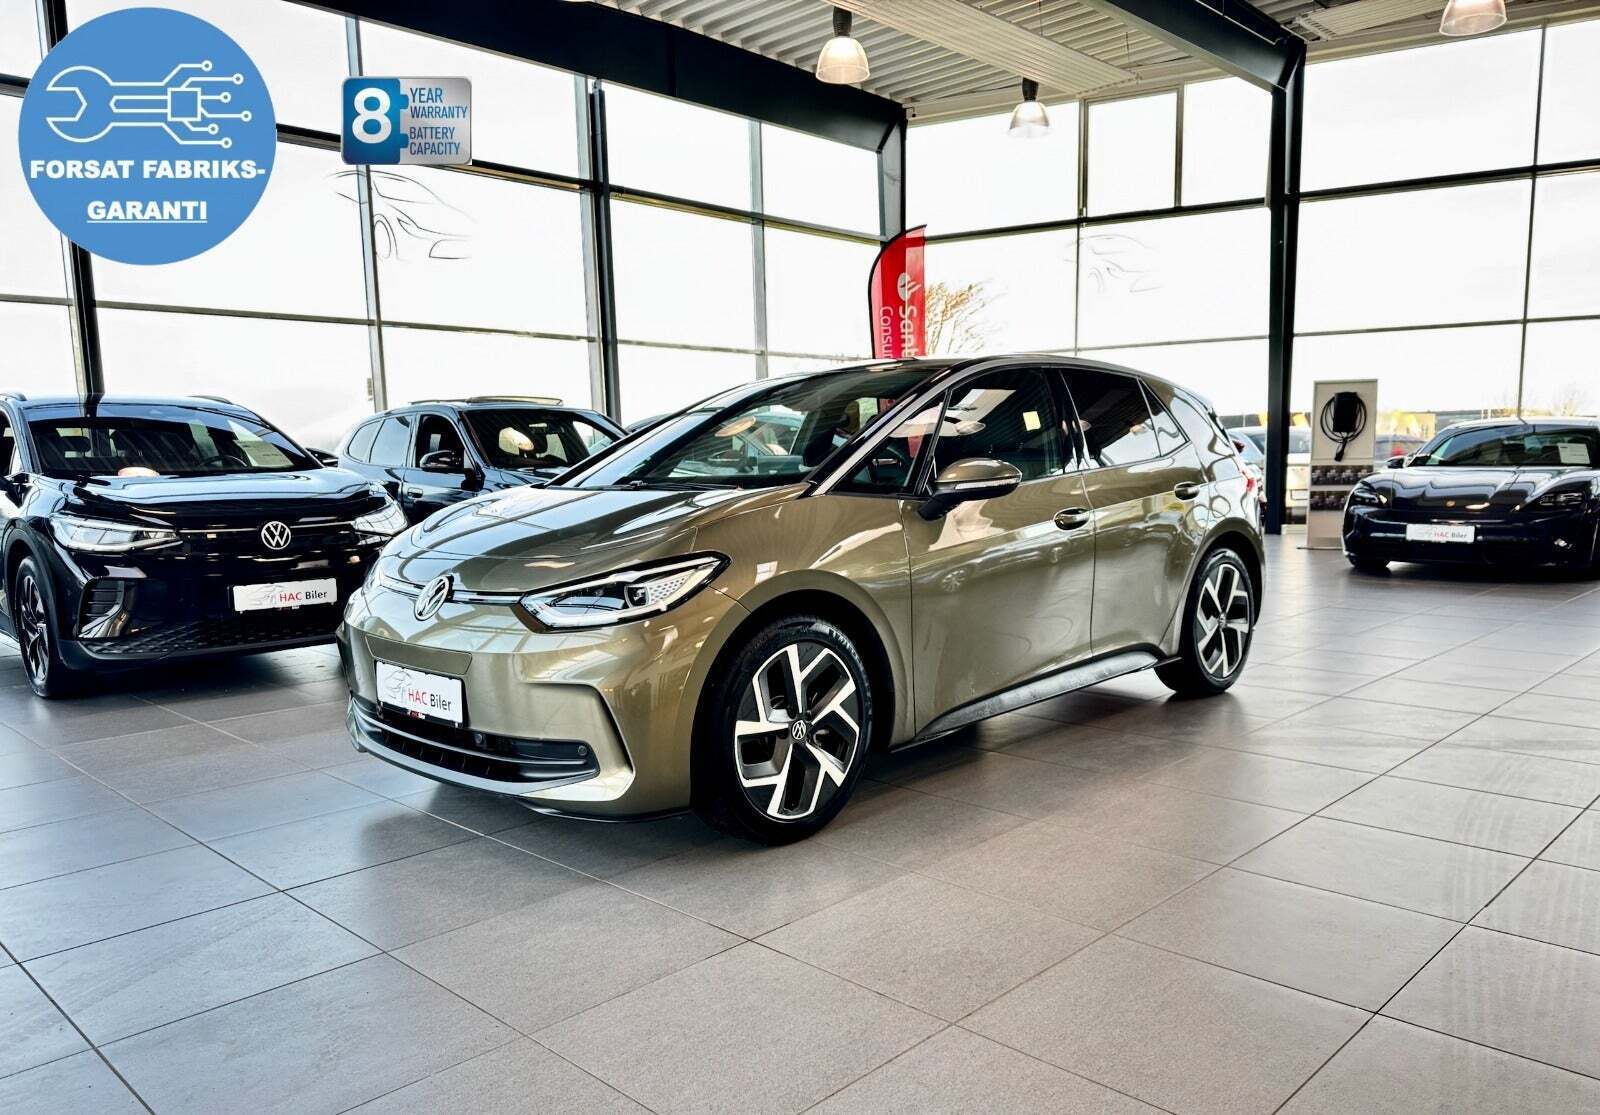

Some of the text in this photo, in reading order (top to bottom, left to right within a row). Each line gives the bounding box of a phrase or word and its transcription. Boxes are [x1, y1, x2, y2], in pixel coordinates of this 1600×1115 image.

[279, 590, 328, 602] HAC Biler
[408, 689, 452, 712] HAC Biler
